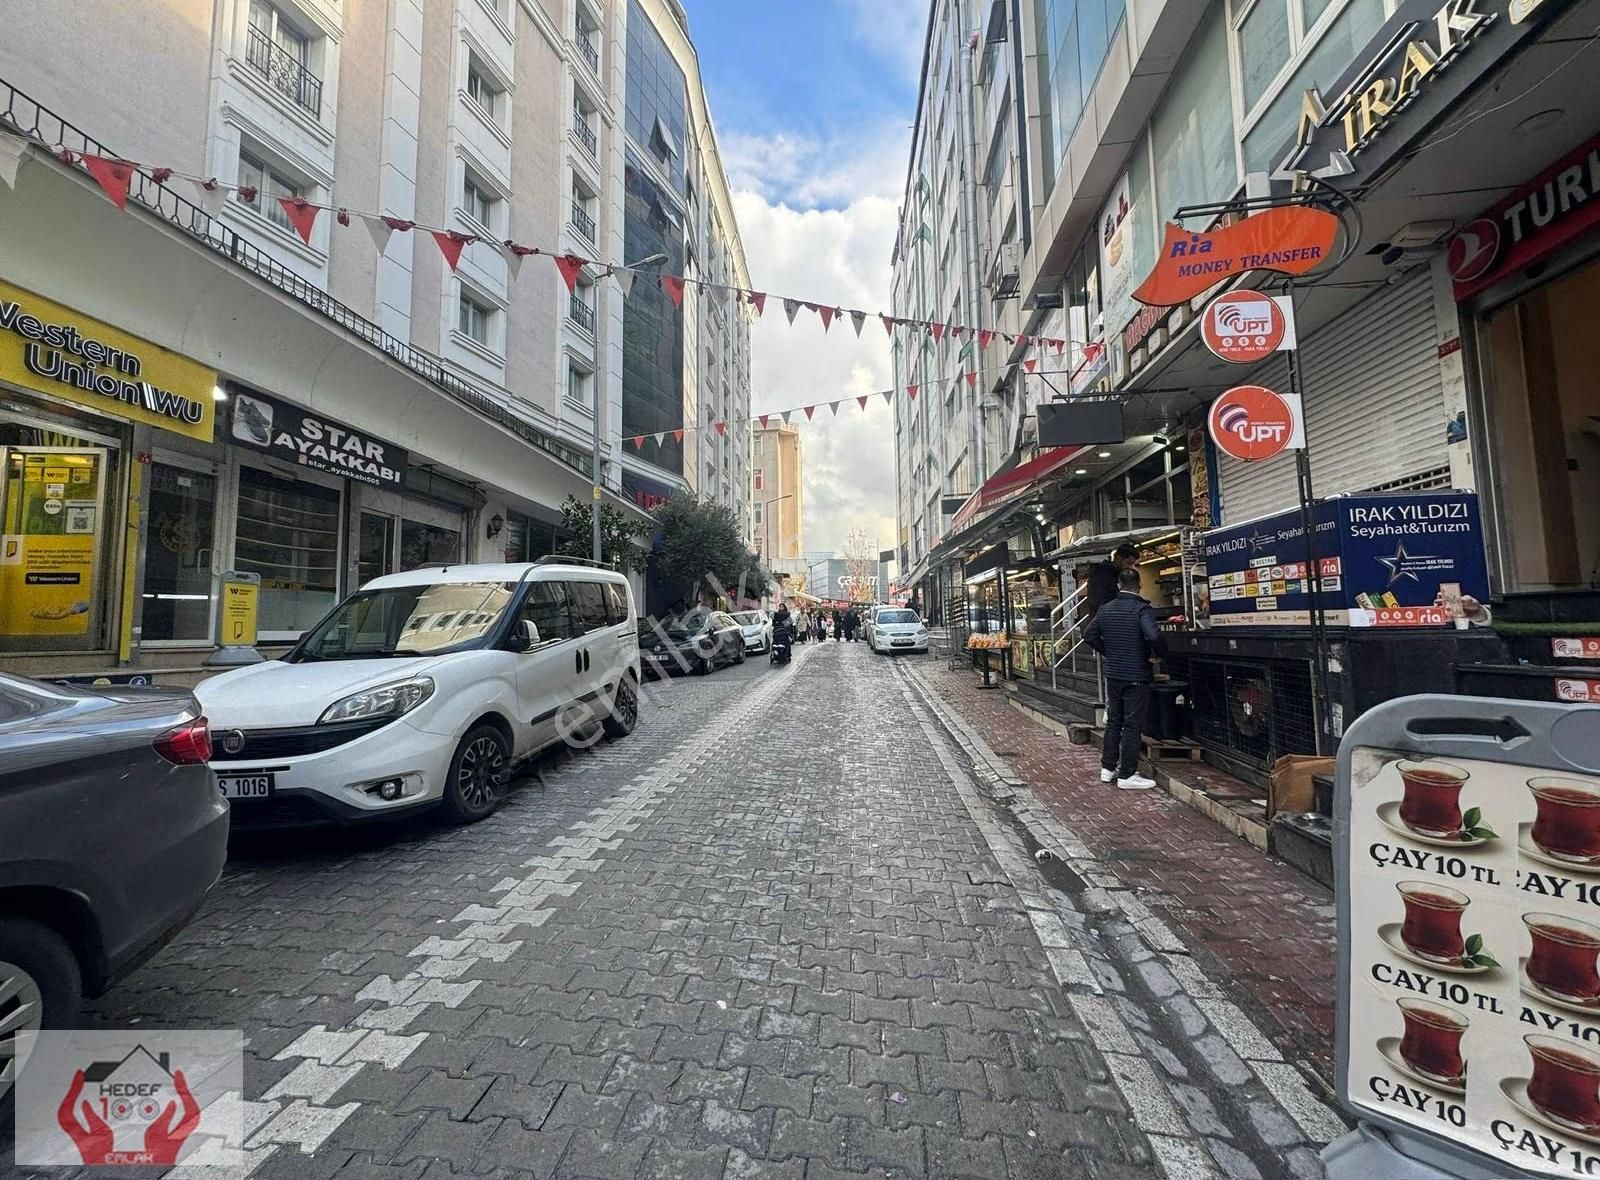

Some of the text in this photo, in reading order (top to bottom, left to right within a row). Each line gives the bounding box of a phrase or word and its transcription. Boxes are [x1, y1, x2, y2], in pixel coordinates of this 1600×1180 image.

[1170, 236, 1213, 258] Ria
[1178, 246, 1321, 278] MONEY TRANSFER
[1233, 320, 1268, 333] UPT
[25, 343, 203, 424] Union WU
[301, 417, 384, 464] STAR
[1239, 425, 1286, 442] UPT
[273, 432, 400, 483] AYAKKABI
[1350, 503, 1468, 523] IRAK YILDIZI
[1322, 562, 1338, 573] ria
[1420, 609, 1441, 623] ria
[1568, 691, 1588, 699] UPT
[236, 778, 266, 796] 1016
[1369, 843, 1500, 885] ÇAY 10 TL
[1516, 870, 1571, 898] AY
[1437, 981, 1469, 1005] 10
[1474, 993, 1503, 1014] TL
[1369, 1076, 1466, 1127] ÇAY 10
[1490, 1119, 1567, 1164] ÇAY
